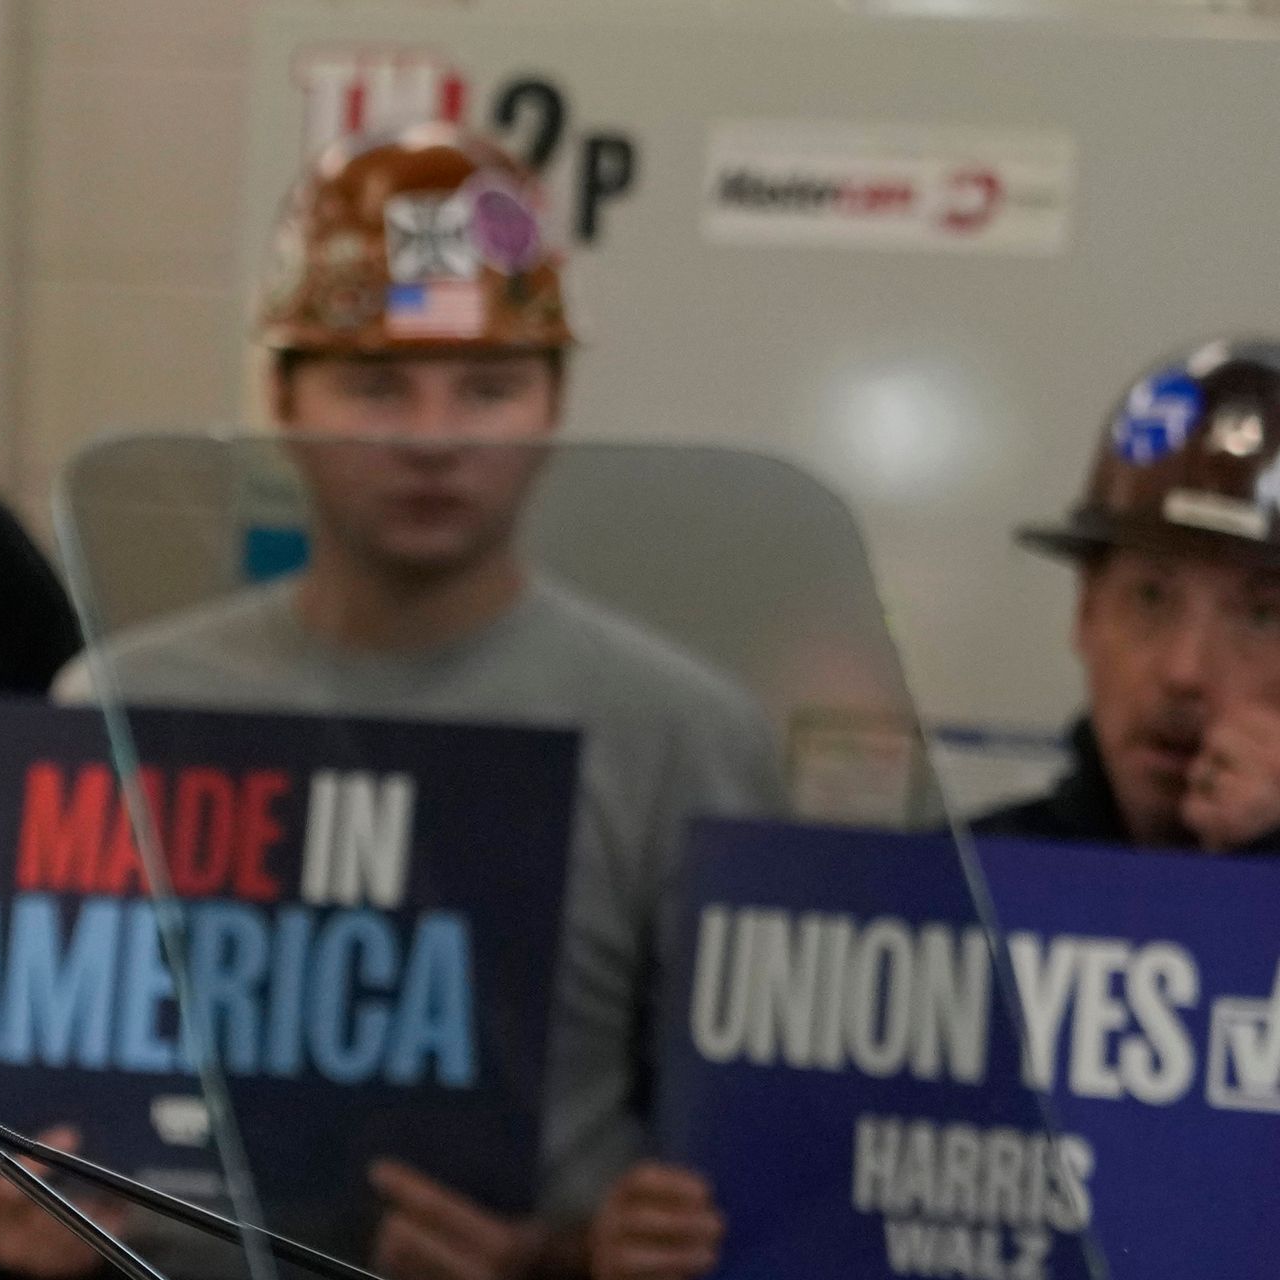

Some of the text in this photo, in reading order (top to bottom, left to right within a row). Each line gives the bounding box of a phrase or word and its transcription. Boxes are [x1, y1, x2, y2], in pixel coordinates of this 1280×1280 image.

[15, 760, 418, 909] MADE IN
[689, 904, 1200, 1107] UNION YES
[855, 1117, 1093, 1231] HARRIS
